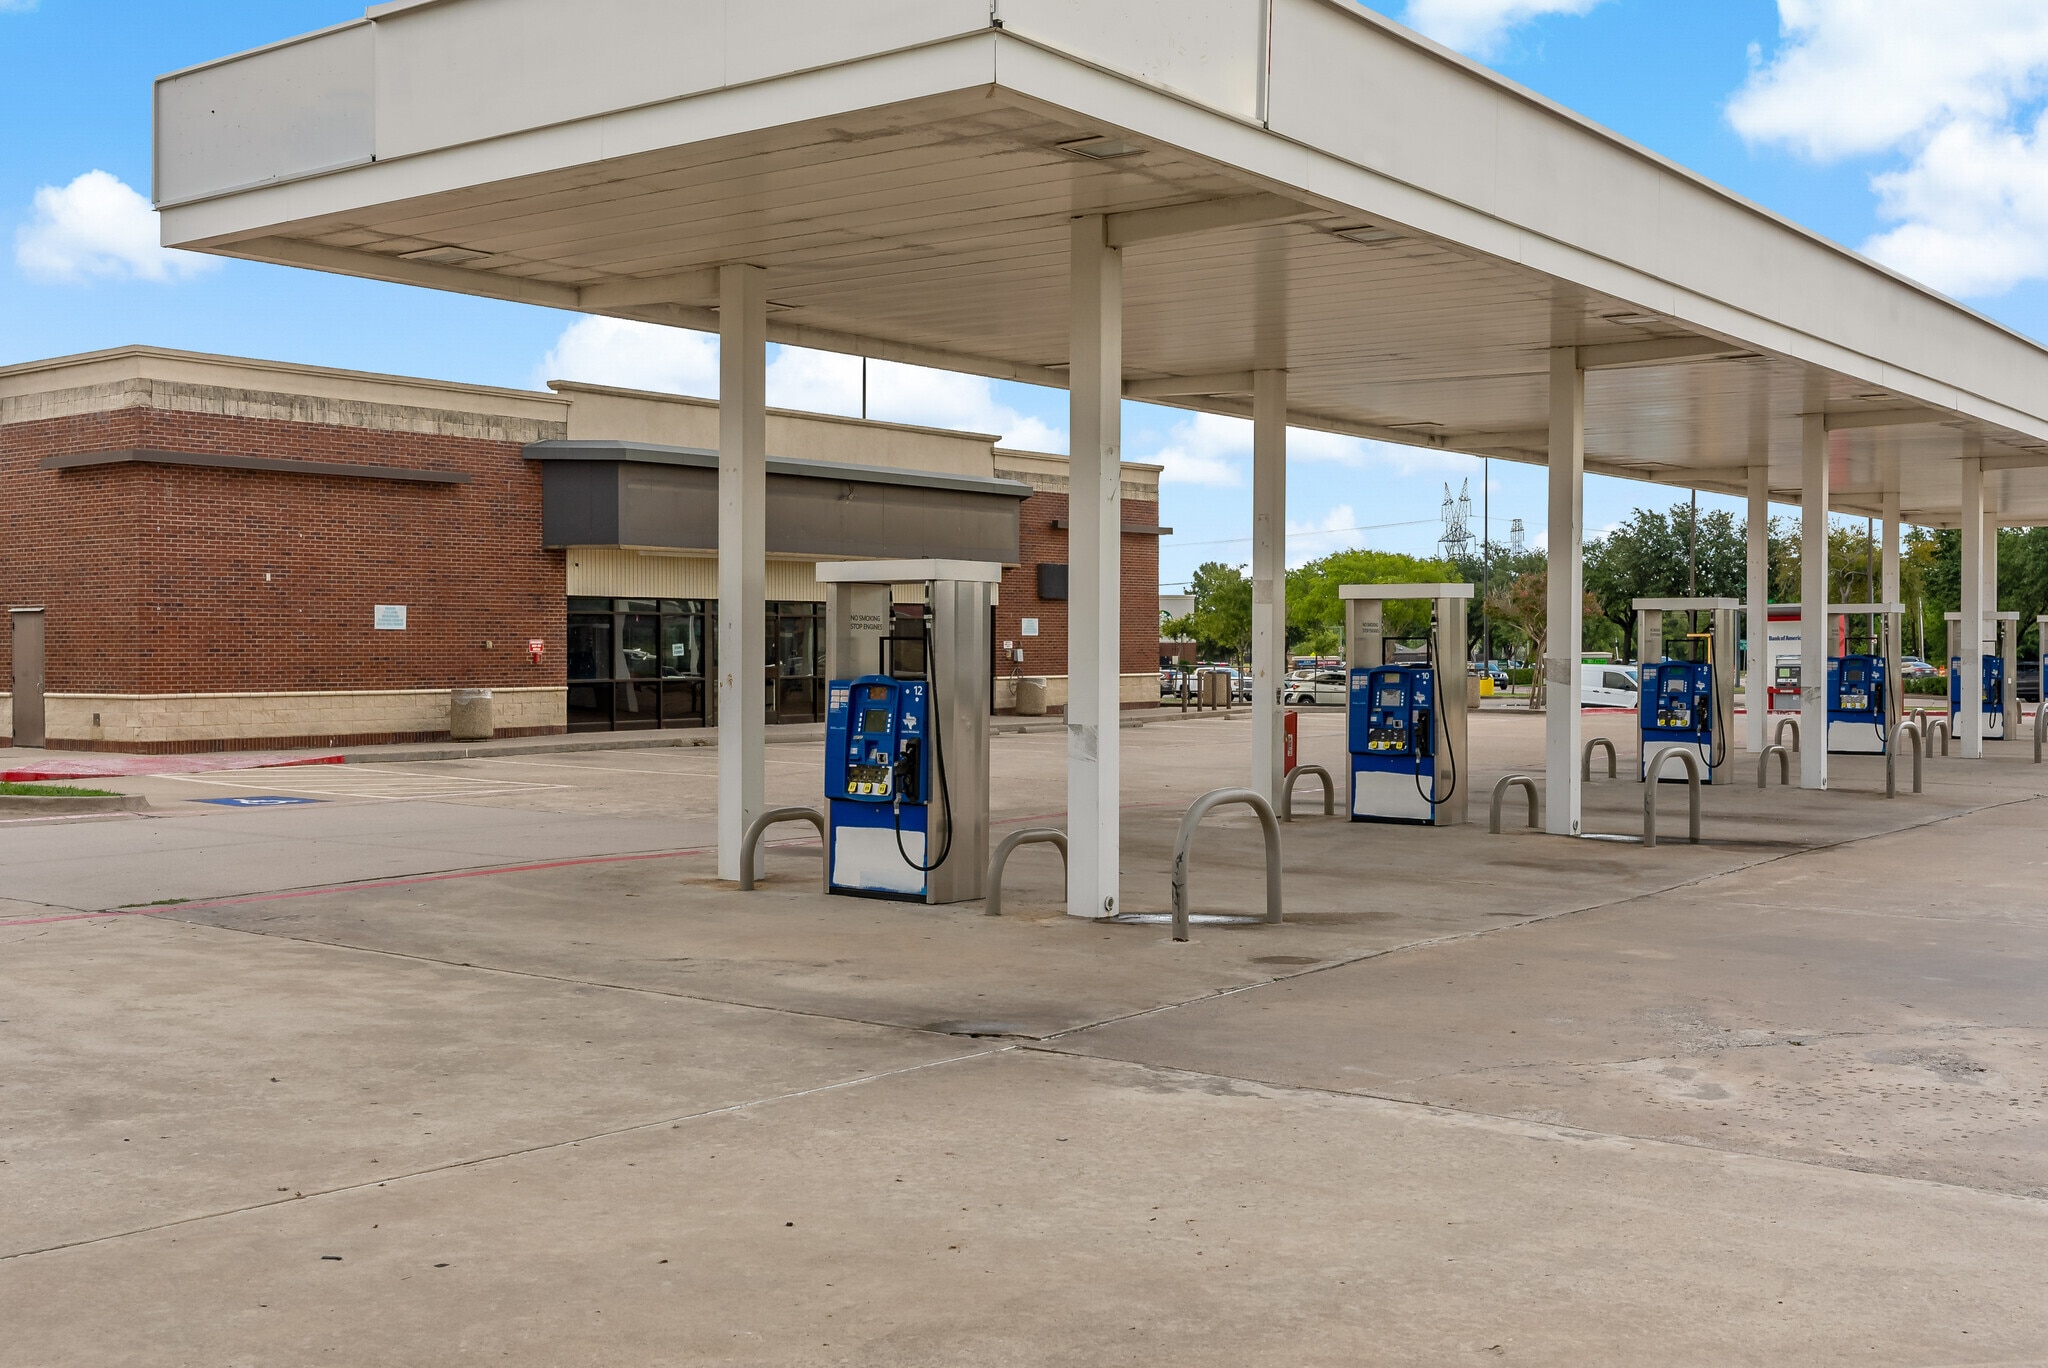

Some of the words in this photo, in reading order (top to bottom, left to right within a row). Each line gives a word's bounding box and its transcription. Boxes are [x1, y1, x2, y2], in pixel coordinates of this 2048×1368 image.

[863, 623, 883, 631] ENGINES
[1421, 672, 1430, 680] 10
[913, 685, 923, 696] 12
